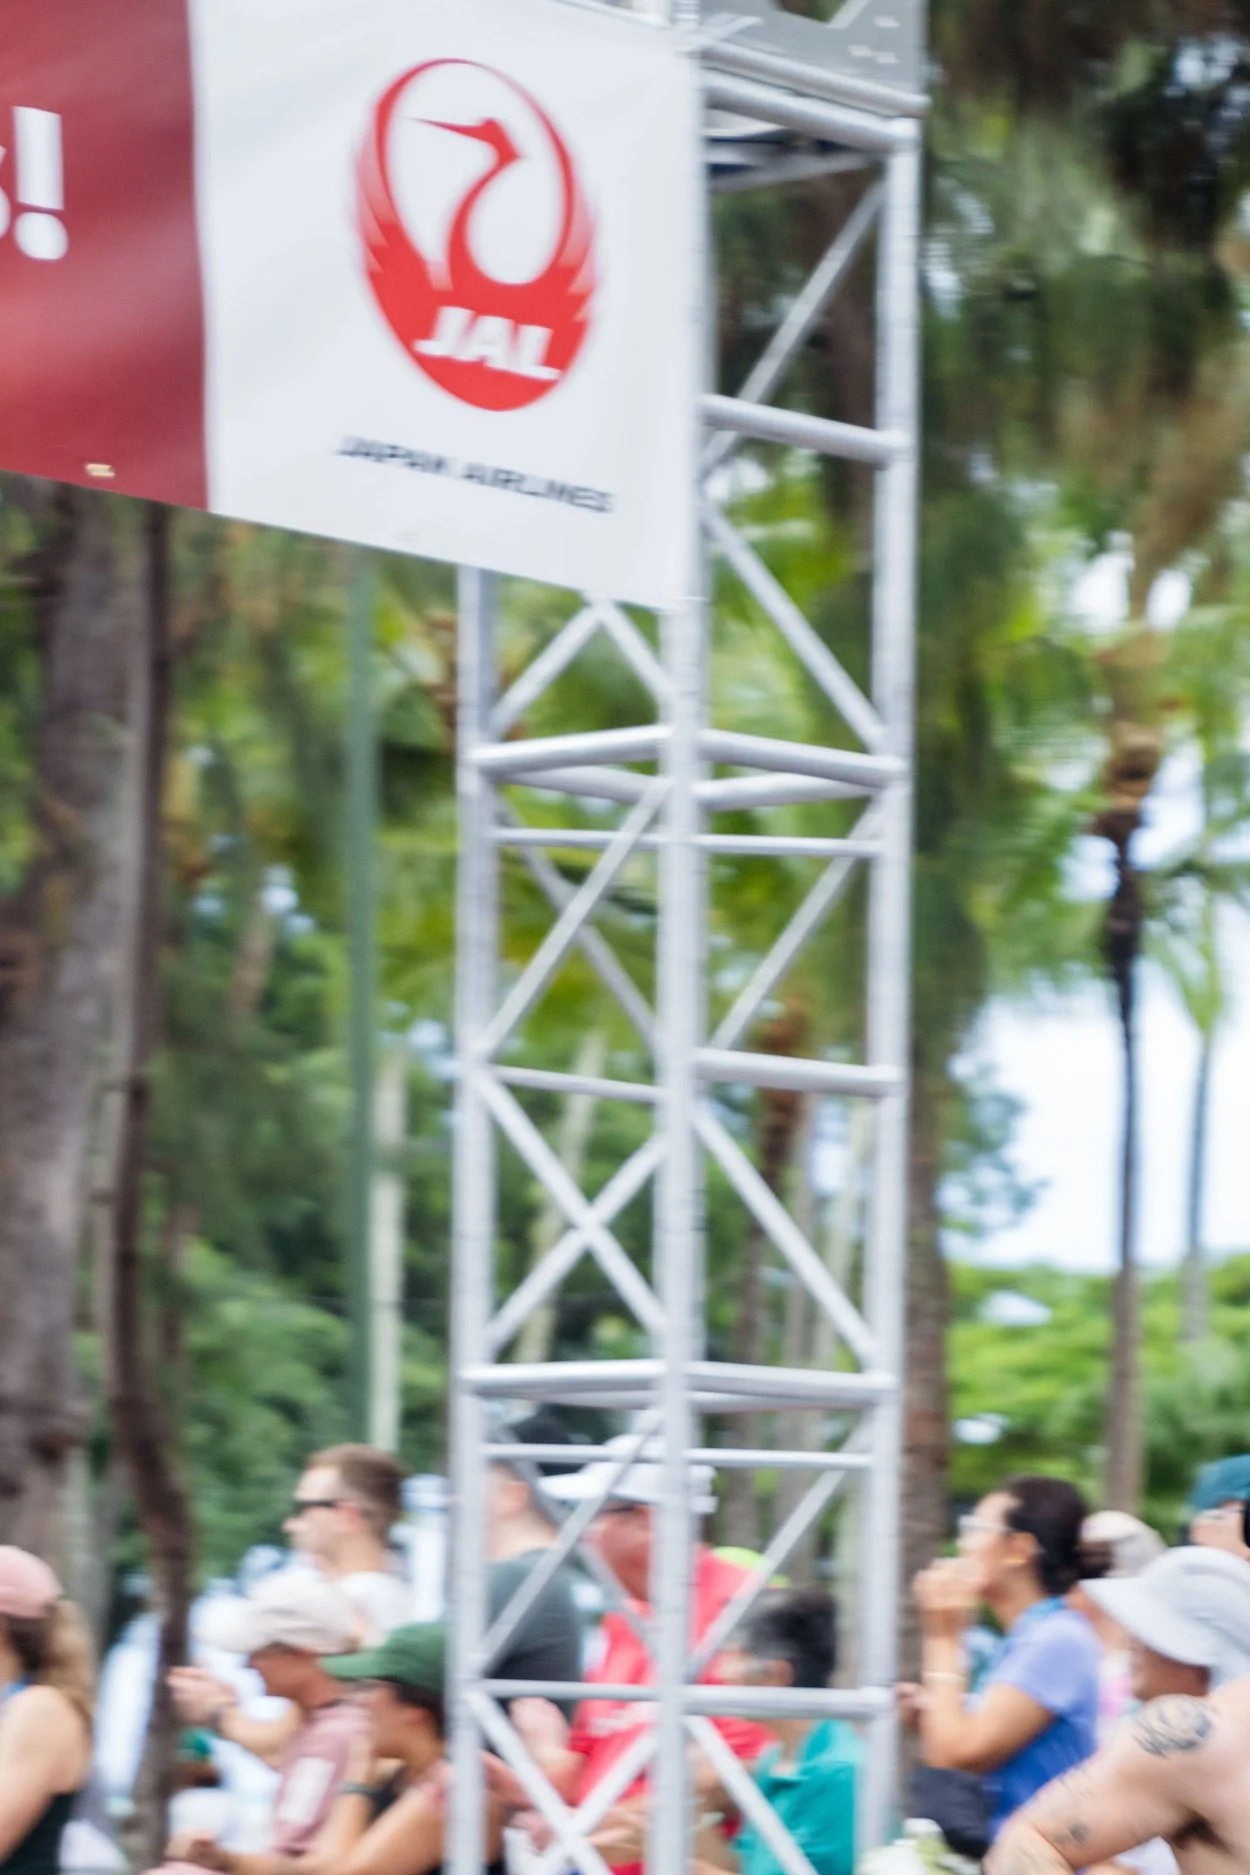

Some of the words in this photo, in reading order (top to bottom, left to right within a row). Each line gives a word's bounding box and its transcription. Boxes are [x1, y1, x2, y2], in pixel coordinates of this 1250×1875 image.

[412, 305, 563, 381] JAL
[337, 434, 450, 477] JAPAN
[462, 462, 615, 513] AIRLINES
